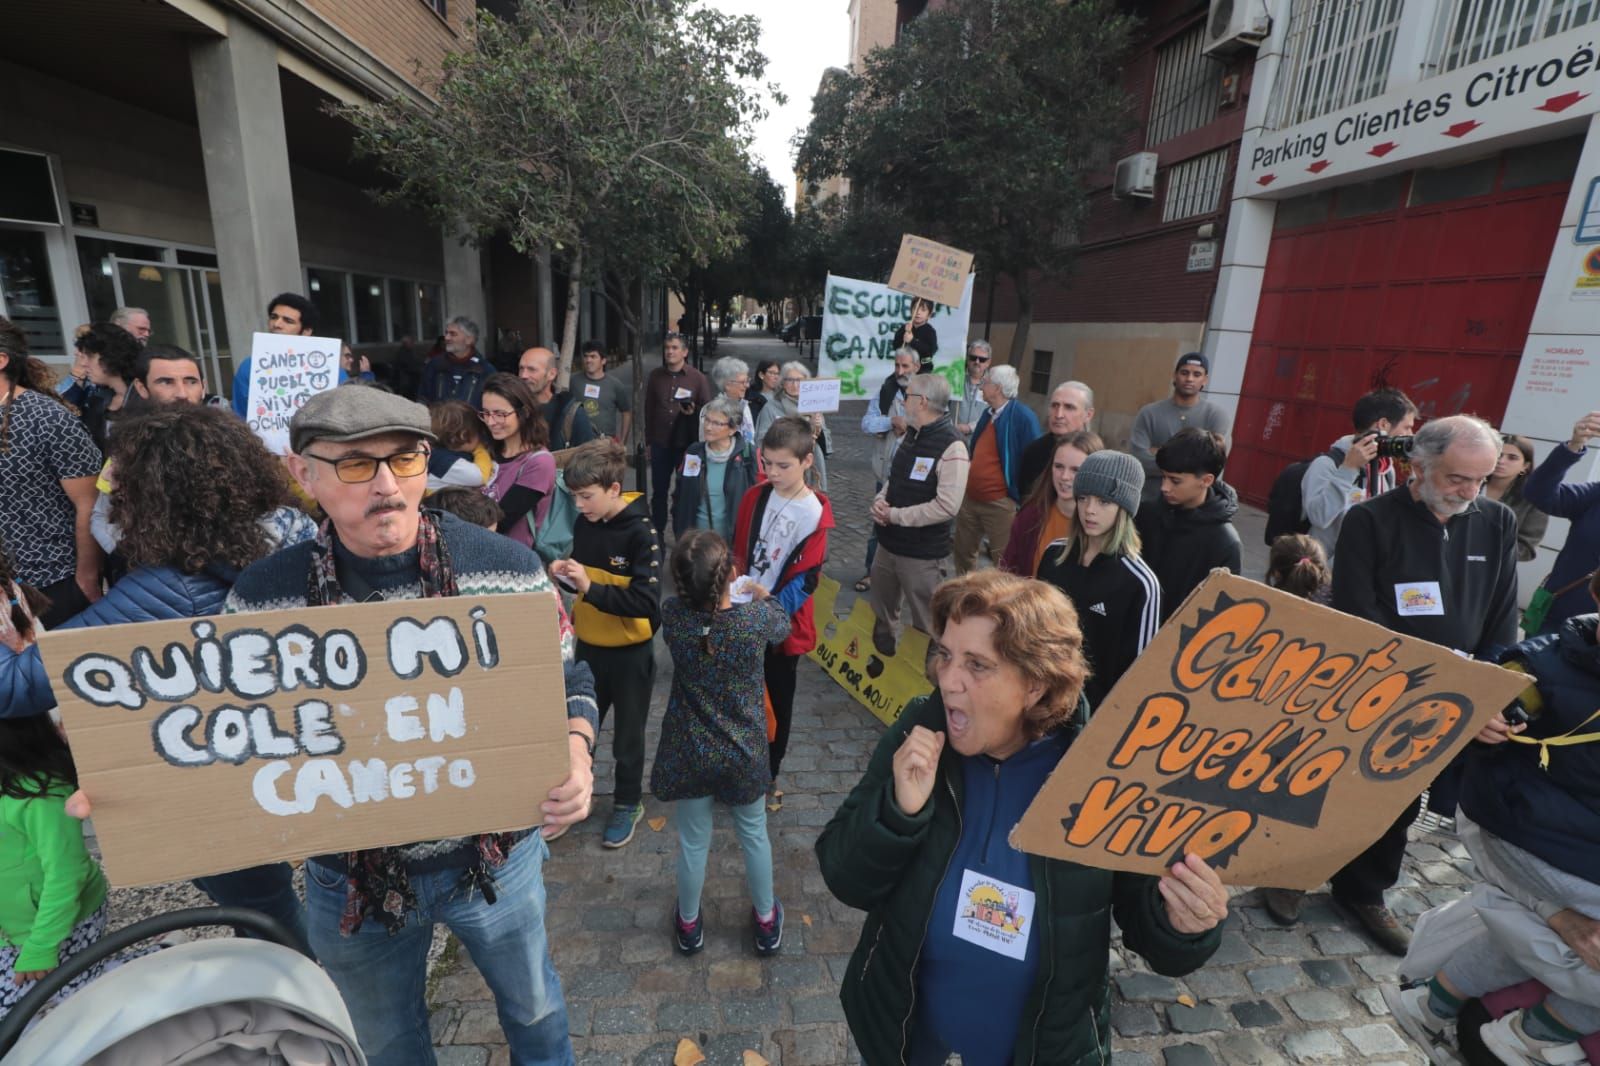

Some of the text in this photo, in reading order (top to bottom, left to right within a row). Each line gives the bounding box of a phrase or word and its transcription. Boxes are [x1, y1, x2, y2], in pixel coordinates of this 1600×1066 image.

[1251, 131, 1327, 170] Parking
[1335, 93, 1451, 146] Clientes
[817, 643, 838, 668] BUS
[839, 662, 862, 691] POR
[1171, 598, 1409, 732] Caneto
[152, 686, 467, 766] COLE EN
[1108, 691, 1350, 796] Pueblo
[252, 756, 475, 816] CANETO
[1064, 776, 1258, 857] Vivo
